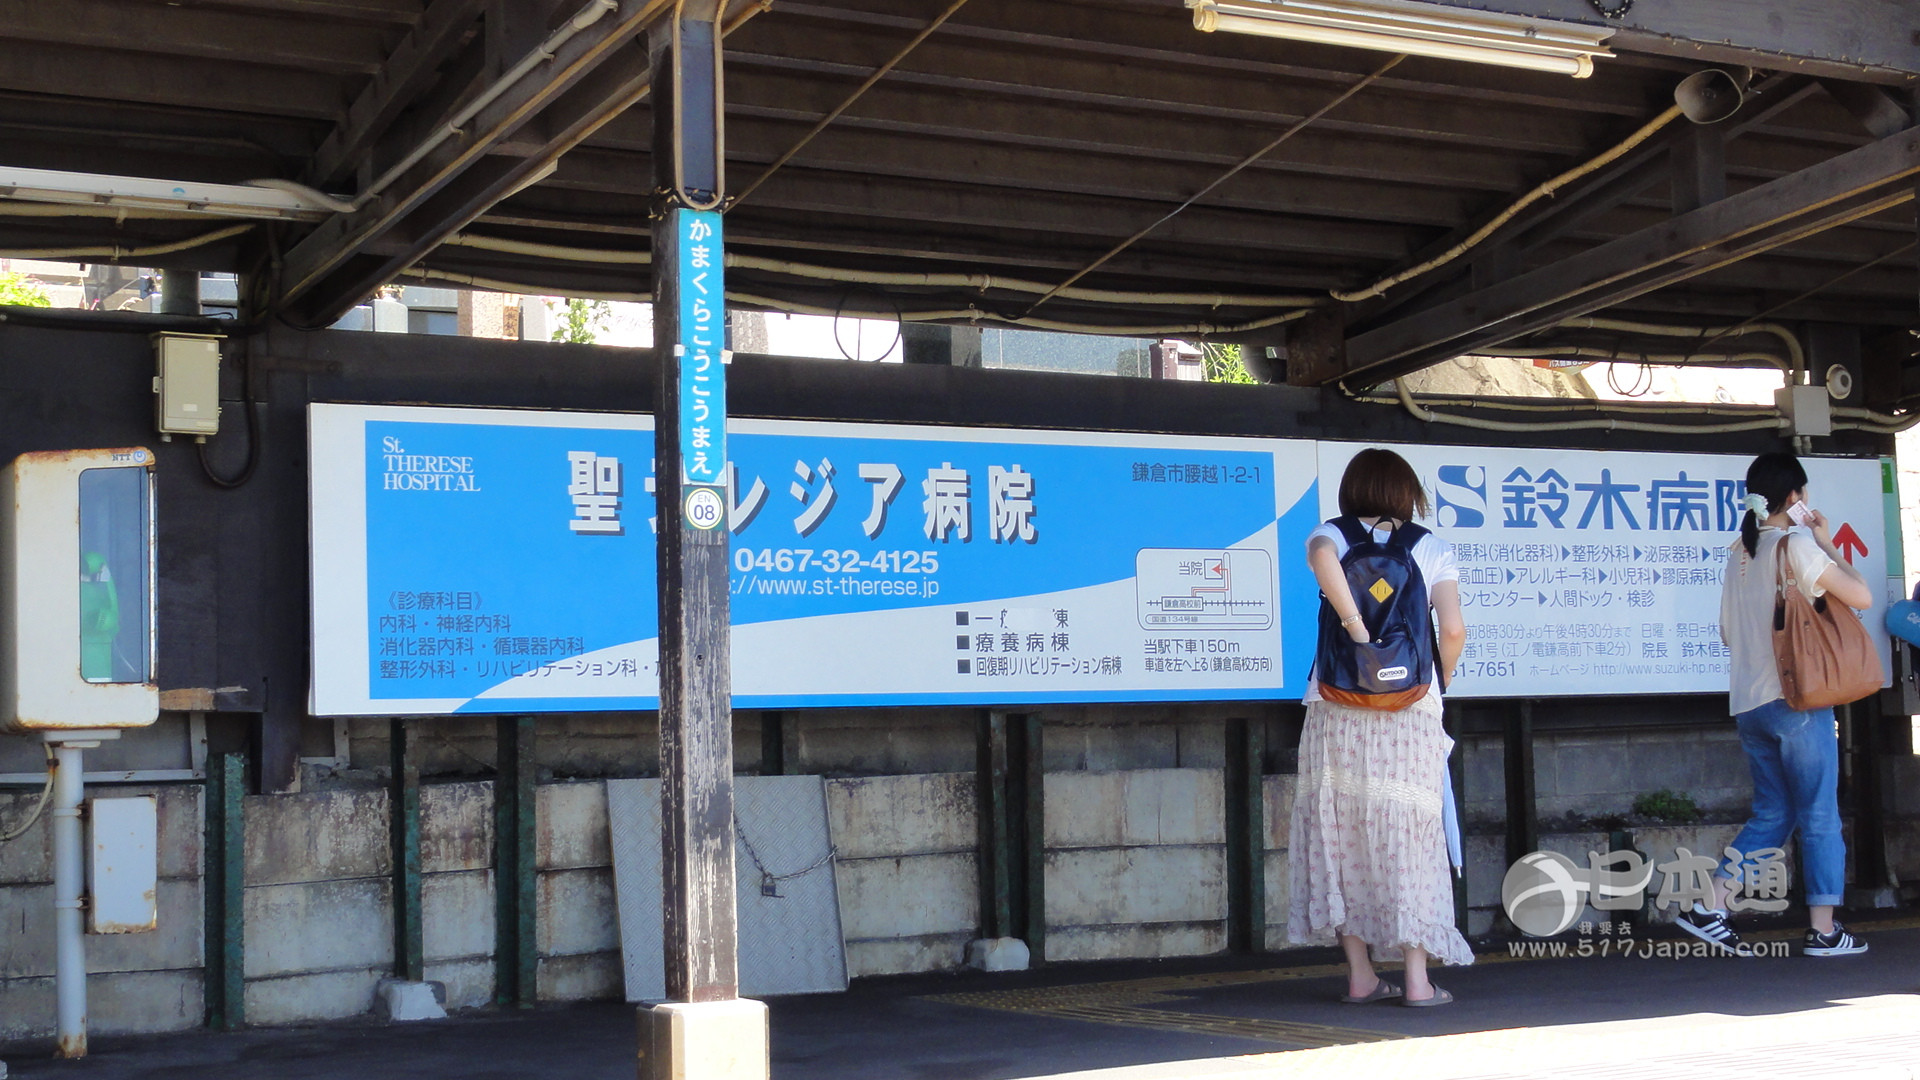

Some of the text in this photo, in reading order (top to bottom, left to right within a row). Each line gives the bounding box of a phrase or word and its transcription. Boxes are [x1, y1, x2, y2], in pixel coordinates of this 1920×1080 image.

[689, 219, 712, 475] かまくらこうこうまえ
[383, 435, 405, 453] St.
[383, 454, 474, 473] THERESE
[1131, 461, 1261, 484] 鎌倉市腰越1-2-1
[383, 472, 481, 492] HOSPITAL
[567, 450, 1037, 543] 聖レジア病院
[693, 504, 715, 520] 08
[734, 547, 940, 575] 0467-32-4125
[1572, 544, 1630, 563] 整形外科
[1644, 545, 1699, 564] 泌尿器科
[1179, 561, 1203, 576] 当院
[1515, 567, 1597, 585] アレルギー科
[1608, 567, 1651, 586] 小児科
[728, 575, 940, 598] ://www.st-therese.jp
[1458, 589, 1656, 609] ンセンター 人間ドック・検診
[379, 614, 512, 634] 内科・神経内科
[379, 636, 585, 657] 消化器内科・循環器内科
[975, 632, 1070, 652] 療養病棟
[1144, 638, 1240, 654] 当駅下車150m
[1642, 641, 1668, 658] 院長
[379, 659, 657, 679] 整形外科・リハビリテーション科・
[976, 655, 1122, 676] 回復期リハビリテーション病棟
[1529, 663, 1590, 677] ホームページ
